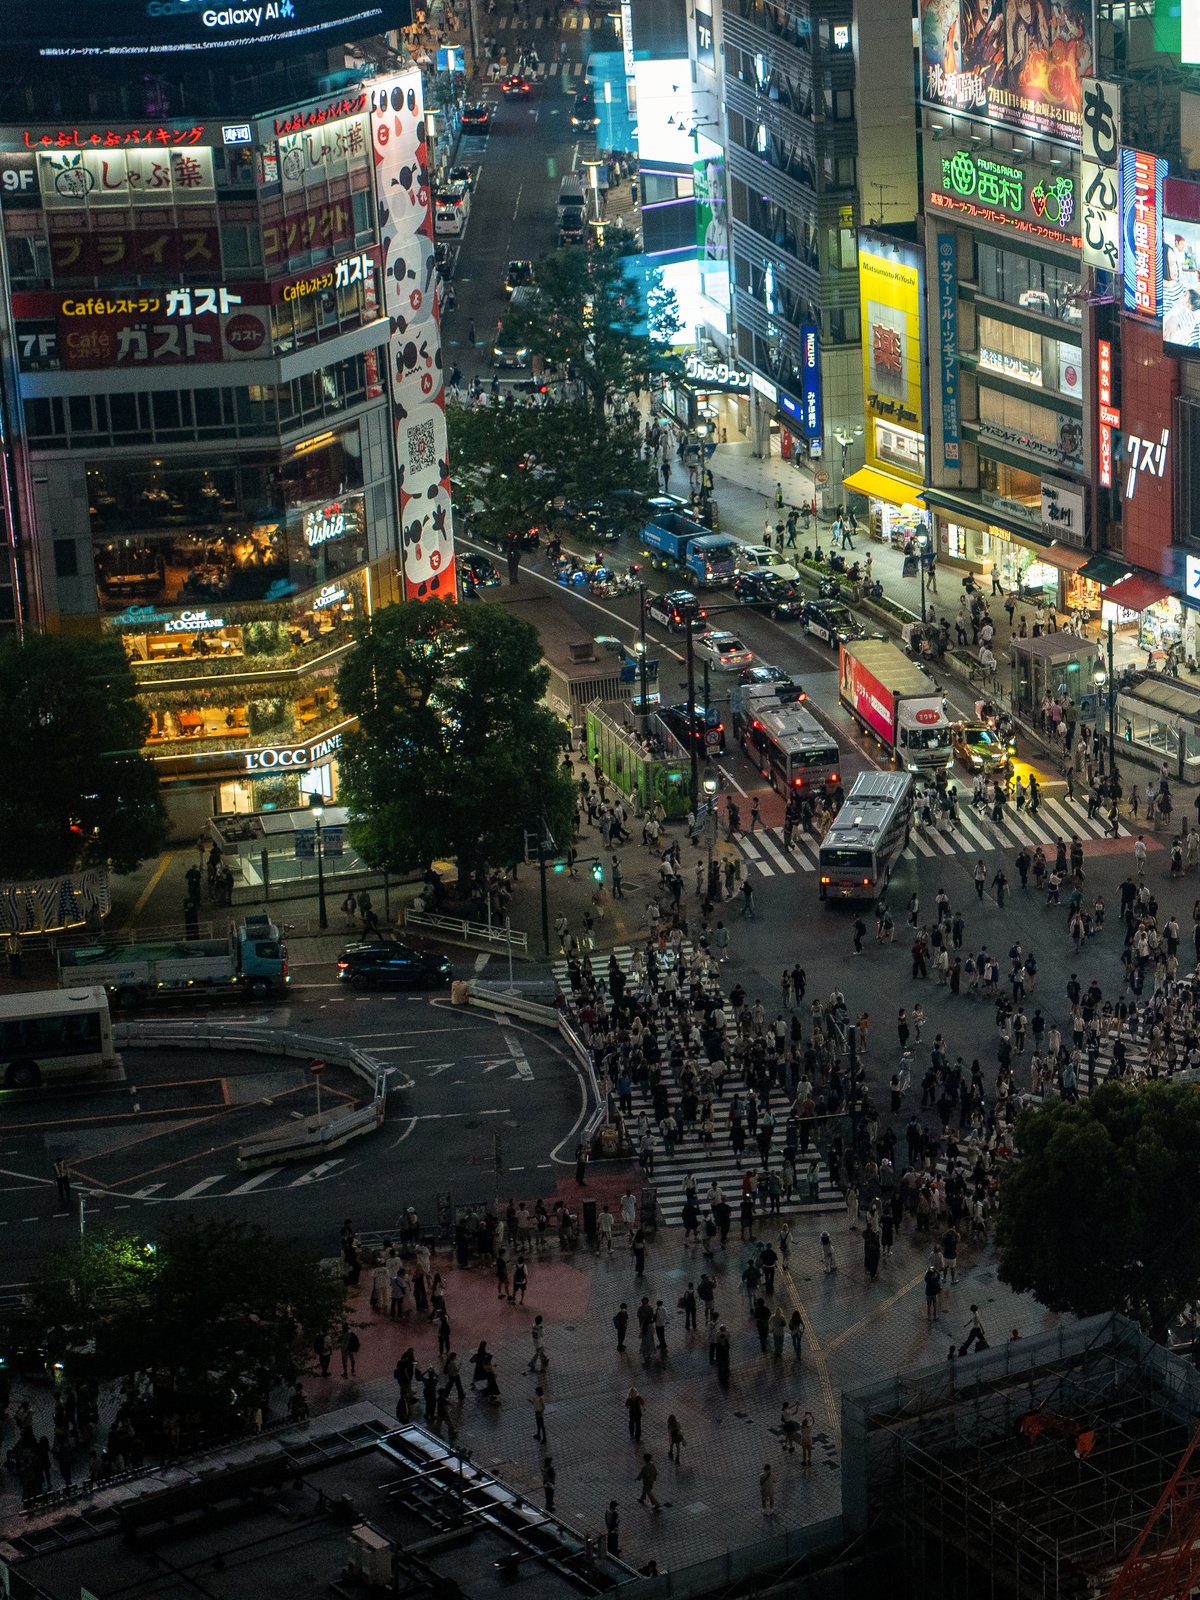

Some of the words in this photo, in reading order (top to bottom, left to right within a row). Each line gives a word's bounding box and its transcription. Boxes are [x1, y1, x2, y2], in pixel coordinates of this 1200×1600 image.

[203, 7, 262, 27] Galaxy
[266, 3, 278, 20] AI
[698, 26, 711, 50] 7F
[274, 93, 367, 136] しゃぶしゃぶバイキング
[23, 126, 204, 149] しゃぶしゃぶバイキング
[306, 121, 364, 166] しゃぶ葉
[2, 169, 34, 191] 9F
[102, 157, 204, 189] しゃぶ葉
[1084, 82, 1118, 268] もんじゃ
[978, 170, 1023, 212] 西村
[263, 205, 349, 255] コンタクト
[1134, 163, 1151, 308] 三千里薬品
[52, 231, 214, 267] プライス
[335, 254, 375, 289] ガスト
[166, 287, 242, 317] ガスト
[18, 333, 56, 357] 7F
[66, 331, 109, 347] Café
[116, 323, 212, 361] ガスト
[231, 331, 262, 342] ガスト
[806, 333, 816, 368] MIZUHO
[872, 322, 903, 375] 薬
[686, 357, 751, 387] グルメタウン
[1126, 428, 1170, 499] クスリ
